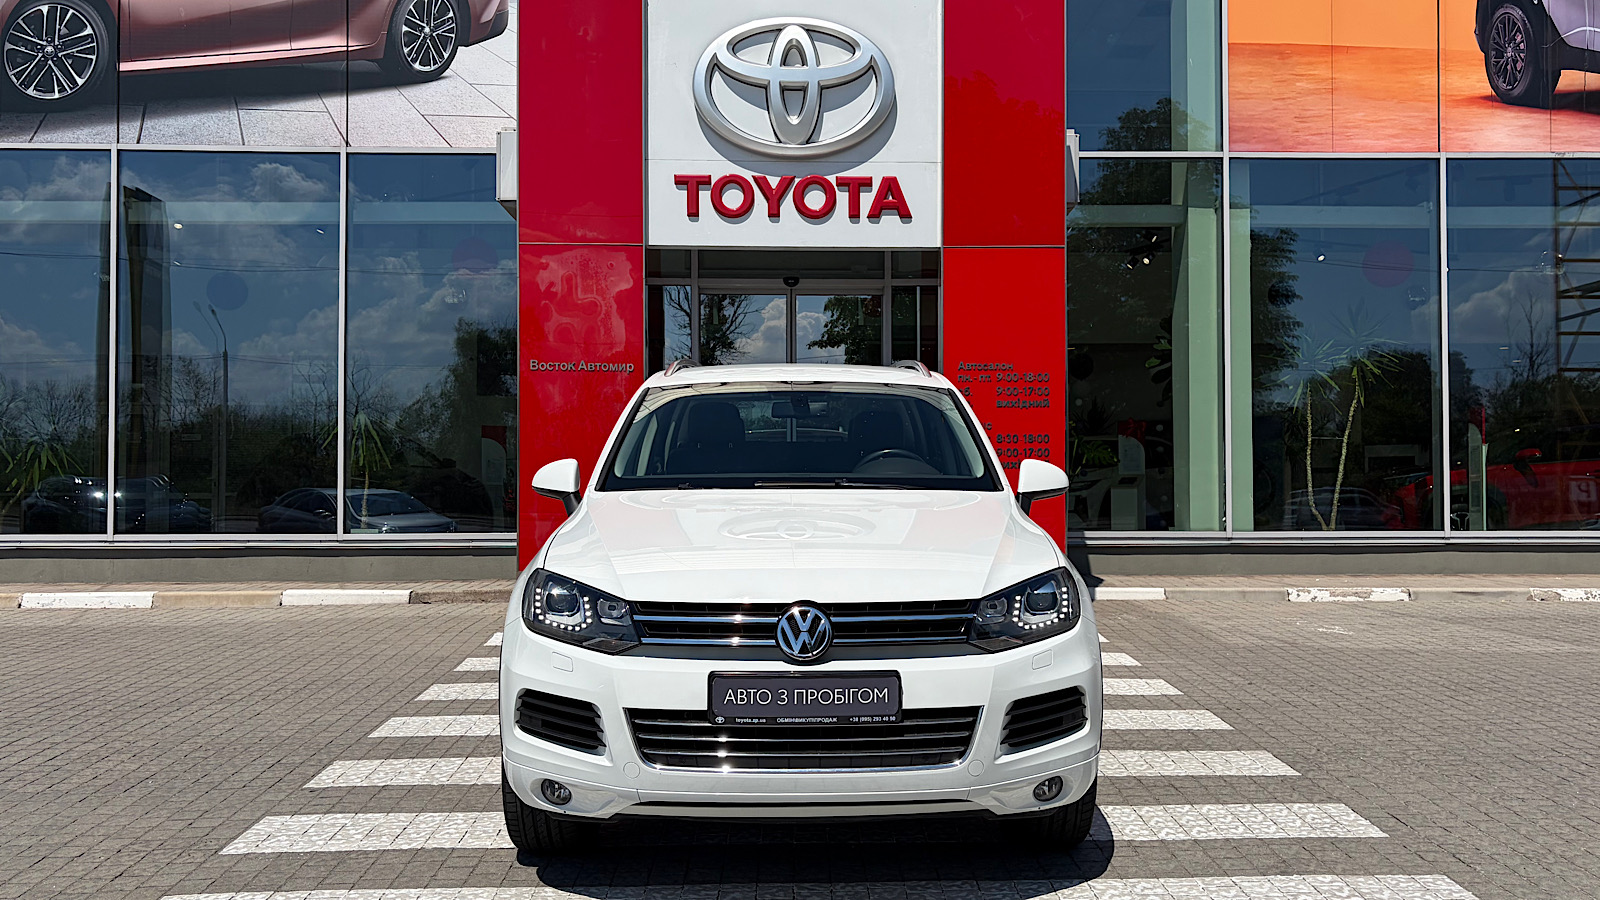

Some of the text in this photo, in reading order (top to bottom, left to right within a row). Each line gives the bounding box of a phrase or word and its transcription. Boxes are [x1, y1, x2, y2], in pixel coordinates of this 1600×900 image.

[674, 173, 913, 220] TOYOTA
[530, 359, 635, 374] Восток Автомир
[957, 361, 1014, 371] Автосалон
[996, 387, 1050, 397] 9:00-17:00
[996, 398, 1050, 409] вихідний
[724, 688, 772, 705] АВТО
[794, 687, 888, 705] ПРОБІГОМ
